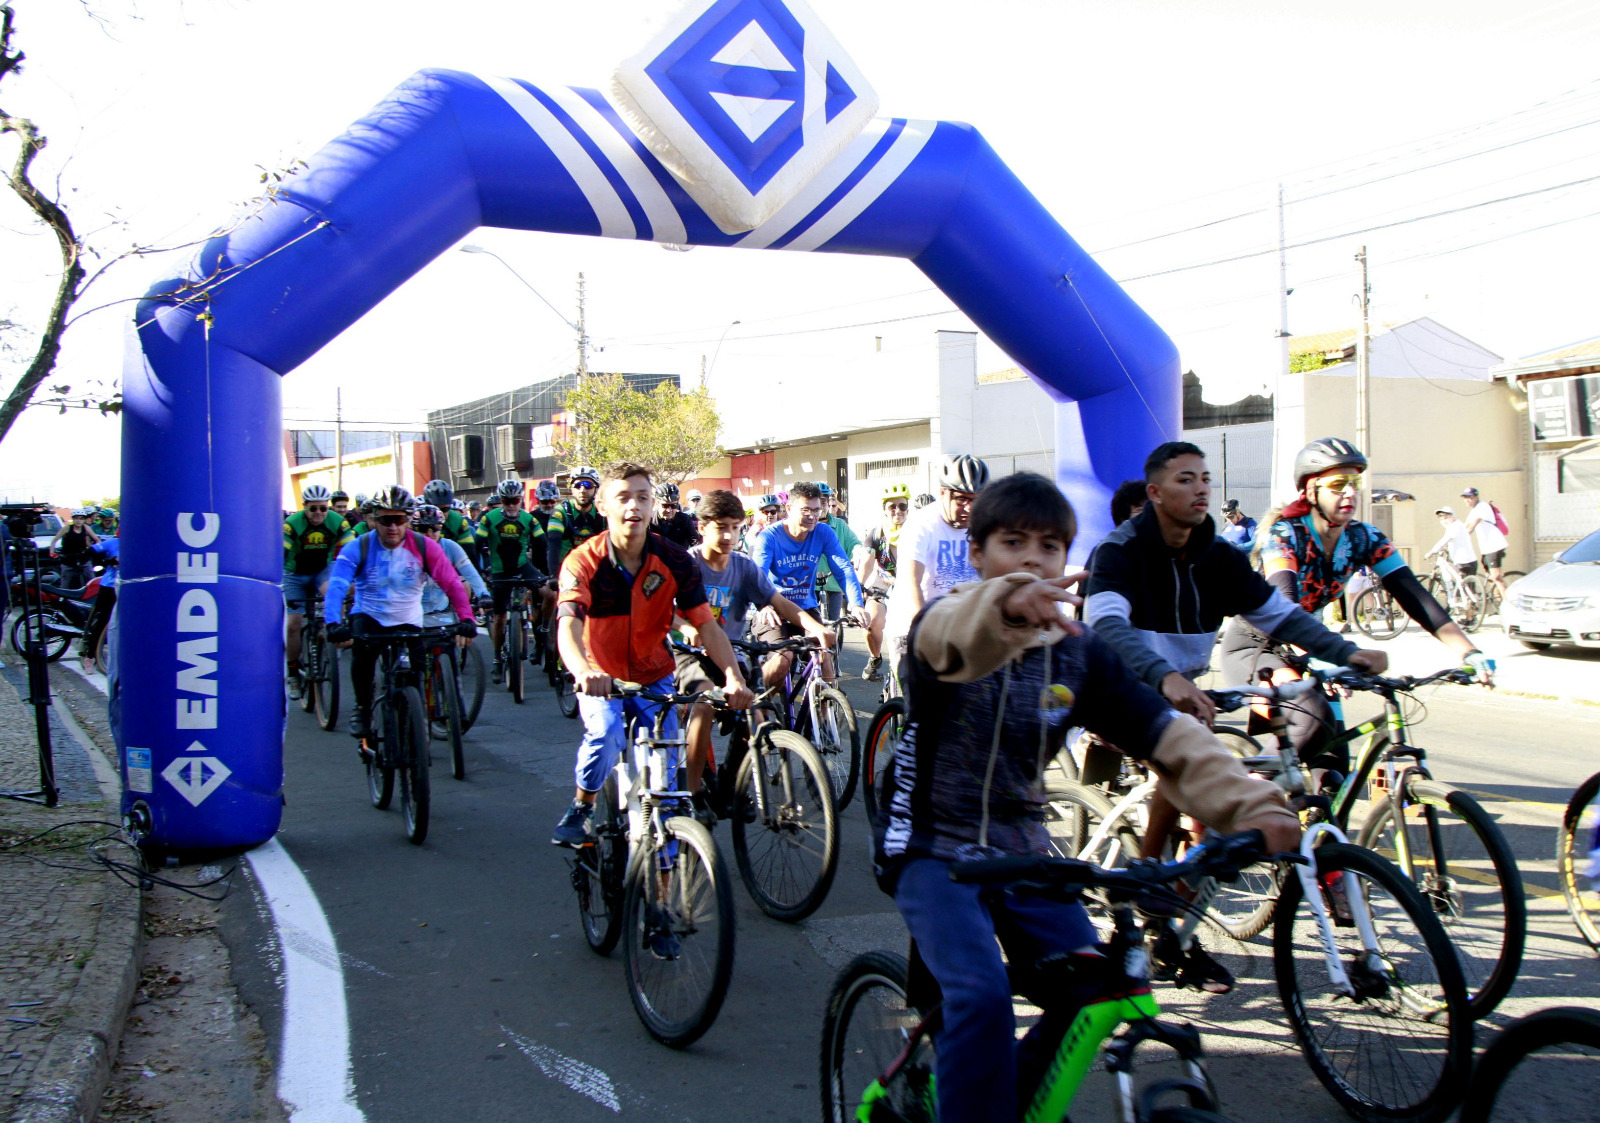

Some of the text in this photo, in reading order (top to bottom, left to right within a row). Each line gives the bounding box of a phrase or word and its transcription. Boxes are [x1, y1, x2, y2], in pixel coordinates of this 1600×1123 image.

[777, 555, 796, 567] PALM
[937, 540, 970, 570] RU
[176, 512, 220, 729] EMDEC
